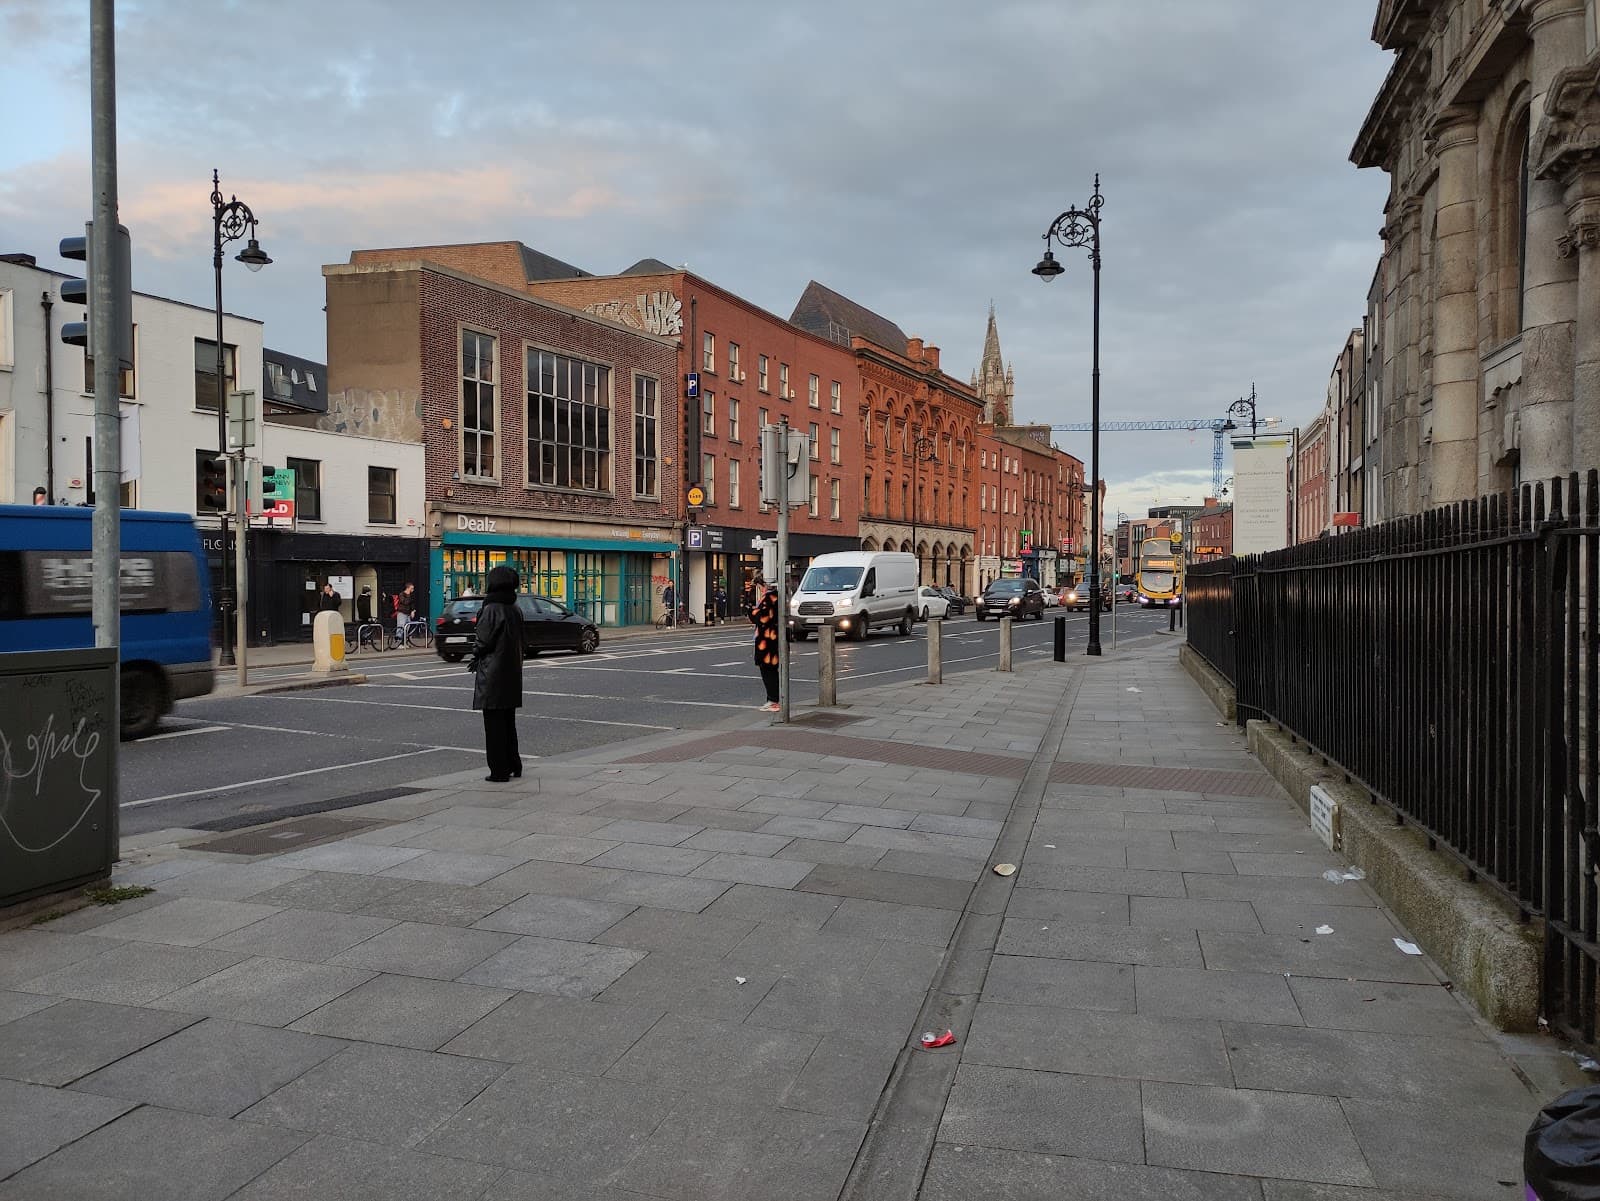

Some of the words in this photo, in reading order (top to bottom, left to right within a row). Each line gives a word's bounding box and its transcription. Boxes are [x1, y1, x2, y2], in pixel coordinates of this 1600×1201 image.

[456, 514, 497, 533] Dealz
[203, 538, 251, 551] FLOI
[690, 532, 700, 545] P
